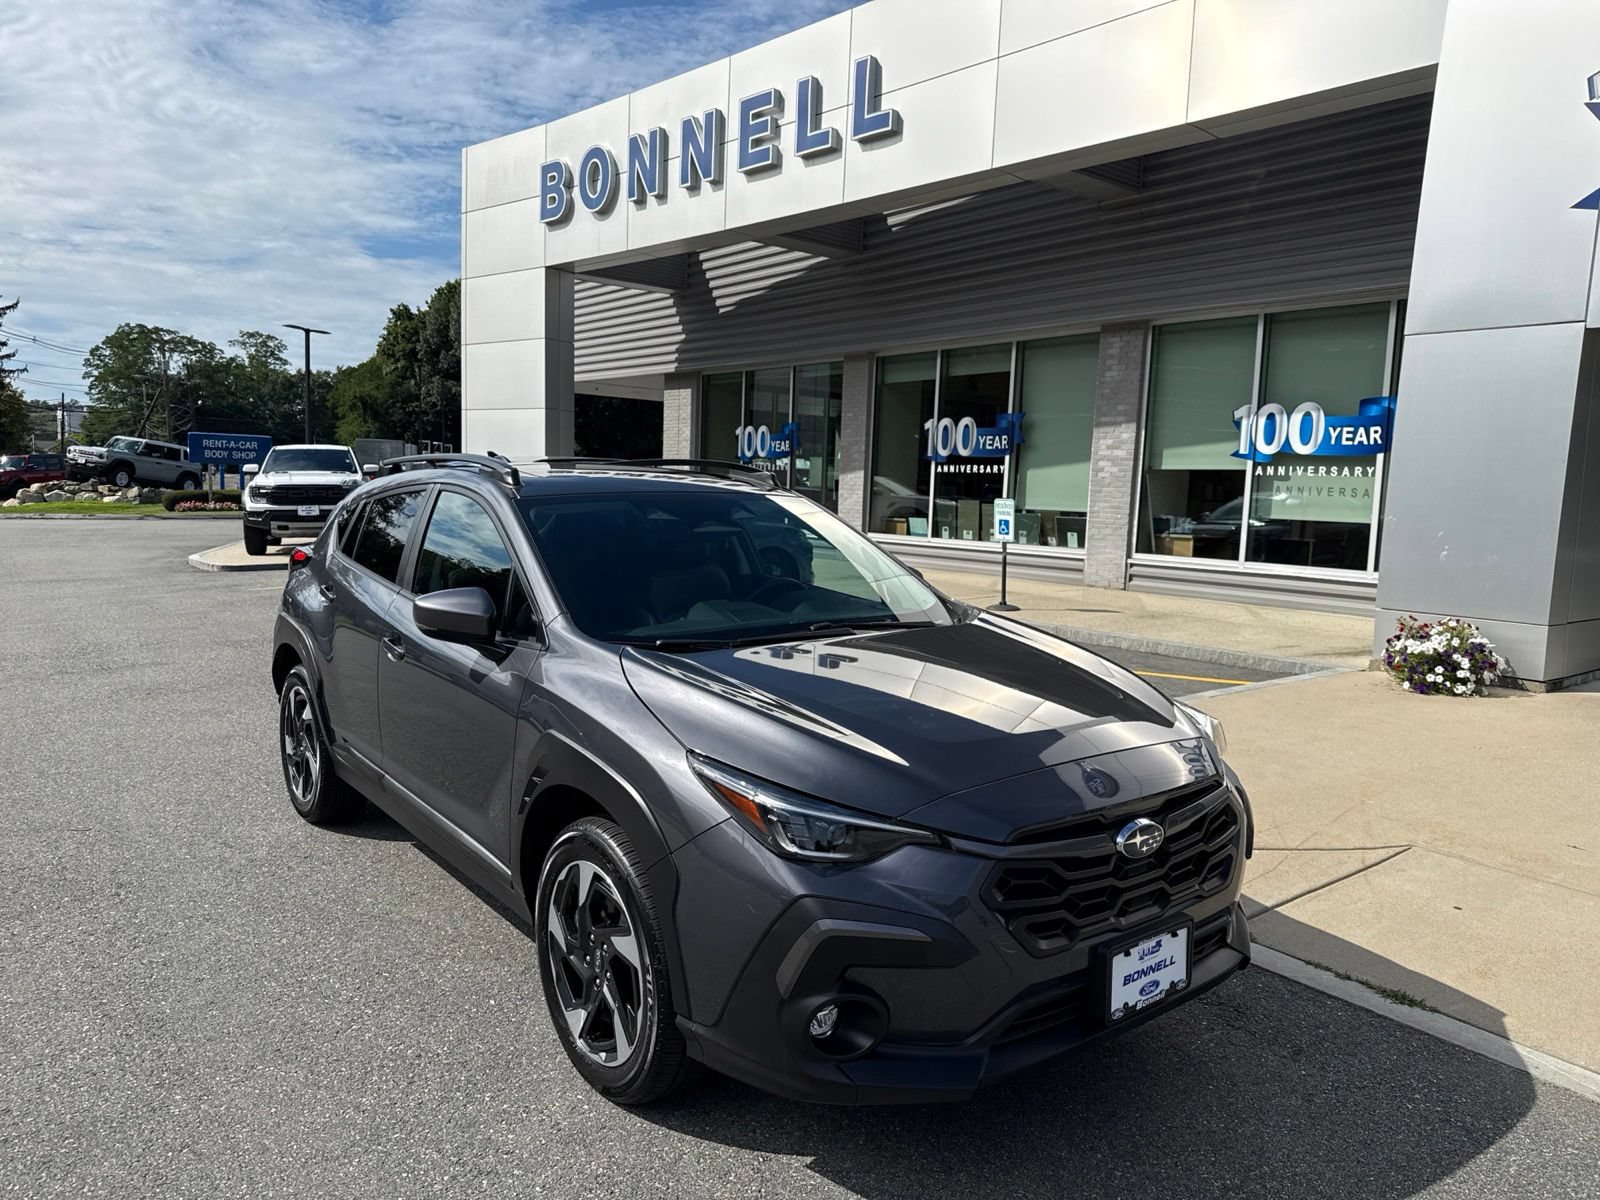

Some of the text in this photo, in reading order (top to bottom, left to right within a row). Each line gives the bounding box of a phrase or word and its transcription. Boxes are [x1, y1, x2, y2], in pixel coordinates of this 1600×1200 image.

[539, 54, 901, 230] BONNELL
[923, 416, 1009, 457] 100 YEAR
[1232, 401, 1383, 455] 100 YEAR
[202, 440, 258, 449] RENT-A-CAR
[204, 450, 256, 459] BODY SHOP
[735, 425, 791, 458] 100 YEAR
[936, 464, 1006, 474] ANNIVERSARY
[1254, 465, 1376, 478] ANNIVERSARY
[1122, 955, 1177, 987] BONNELL
[1135, 990, 1167, 1011] Bonnell
